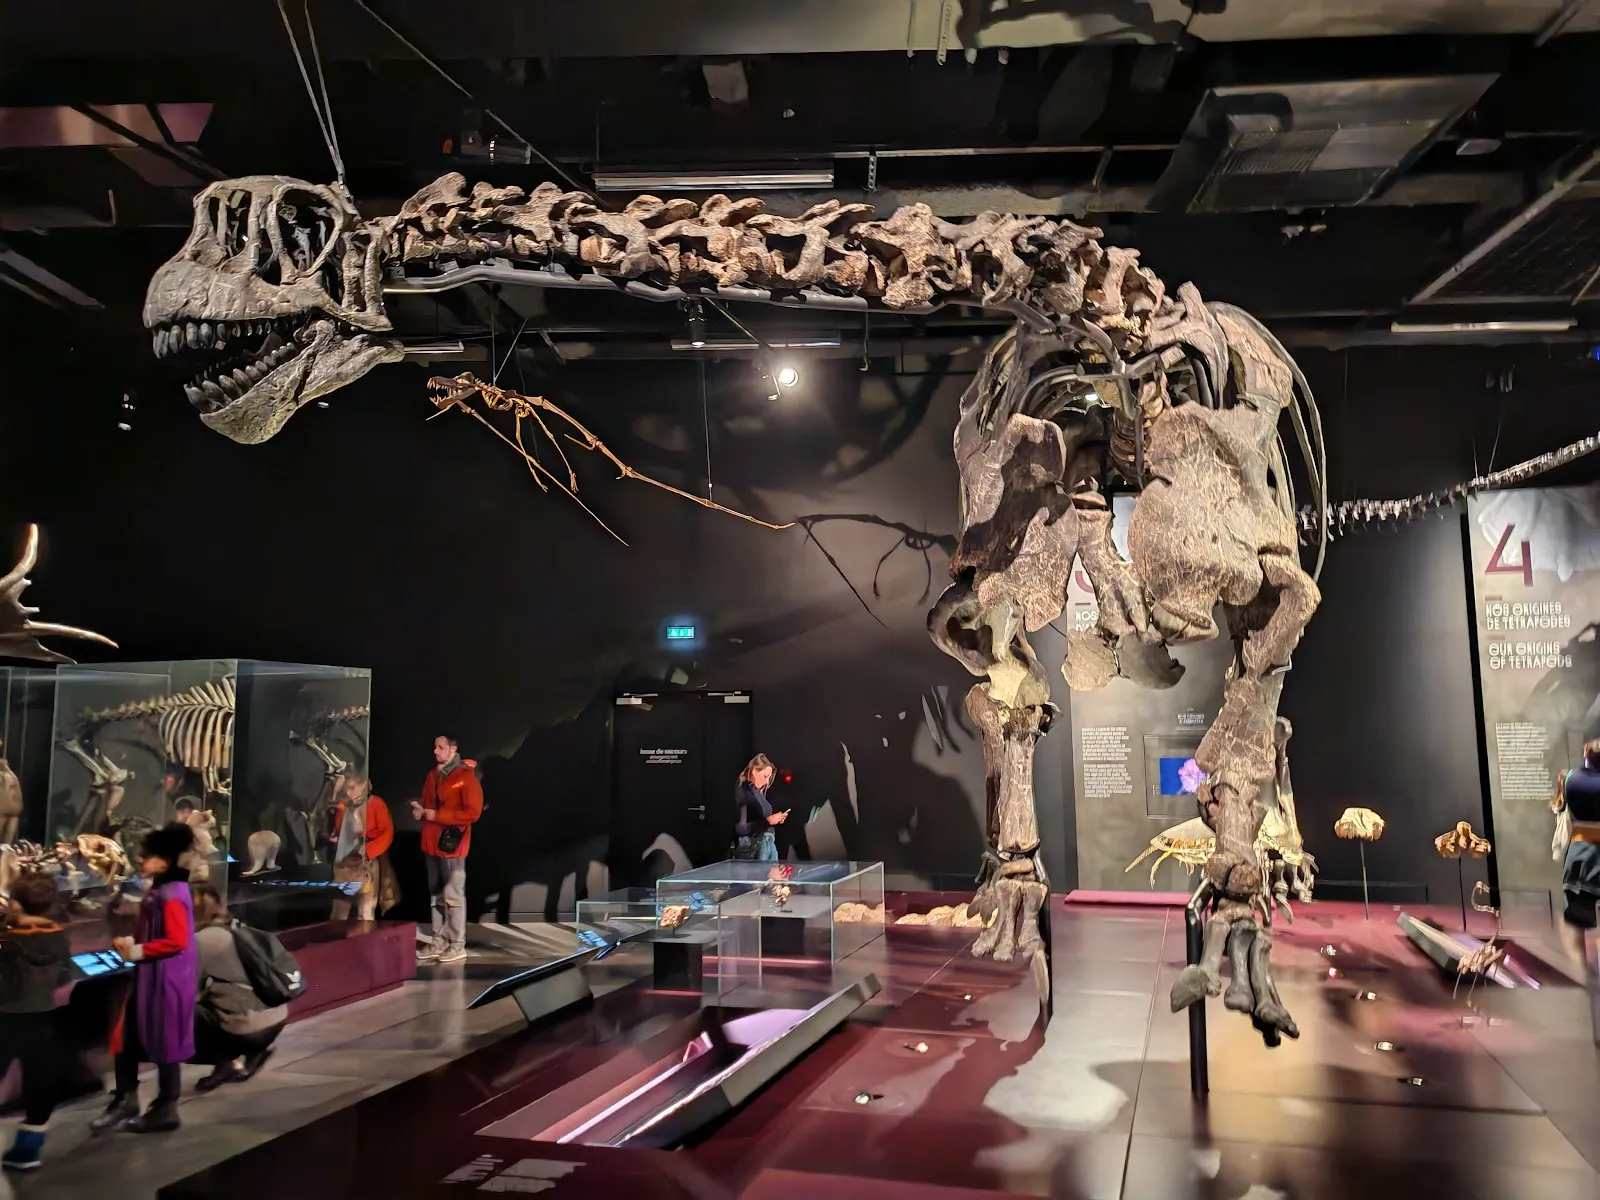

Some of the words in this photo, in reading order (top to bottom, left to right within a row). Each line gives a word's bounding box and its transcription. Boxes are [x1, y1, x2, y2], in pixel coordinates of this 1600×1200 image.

[1485, 523, 1533, 587] 4
[1075, 610, 1098, 622] NOS
[1485, 603, 1509, 617] NOS
[1512, 602, 1561, 616] ORIGINES
[1487, 617, 1500, 630] DE
[1489, 642, 1512, 656] OUR
[1516, 641, 1560, 656] ORIGINS
[1490, 656, 1506, 670] OF
[1509, 654, 1572, 669] TETRAPODS
